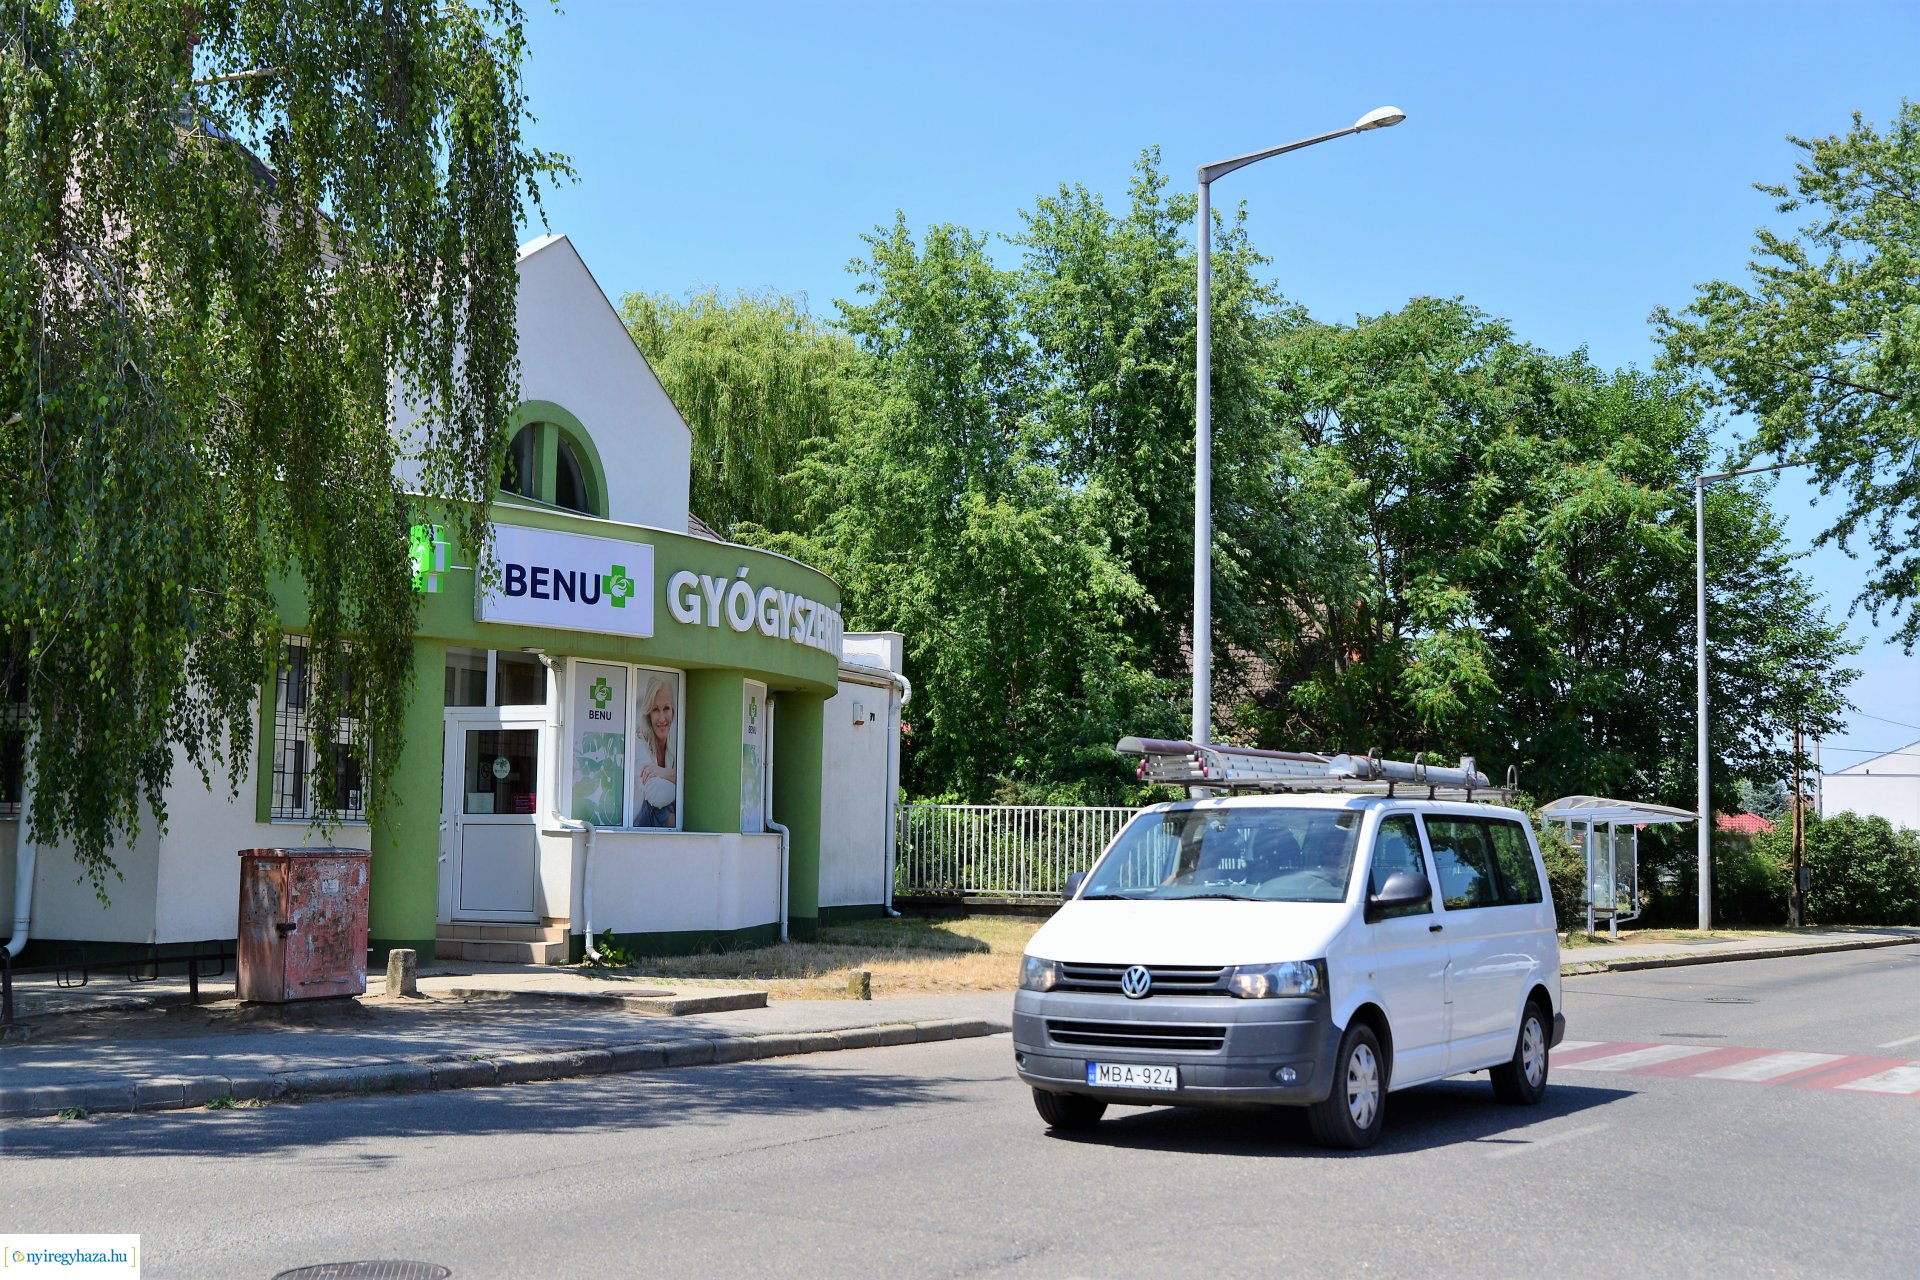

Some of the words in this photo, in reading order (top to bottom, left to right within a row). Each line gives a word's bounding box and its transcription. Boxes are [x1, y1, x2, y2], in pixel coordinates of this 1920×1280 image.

[506, 564, 601, 605] BENU
[589, 710, 612, 721] BENU
[1100, 1066, 1172, 1085] MBA-924
